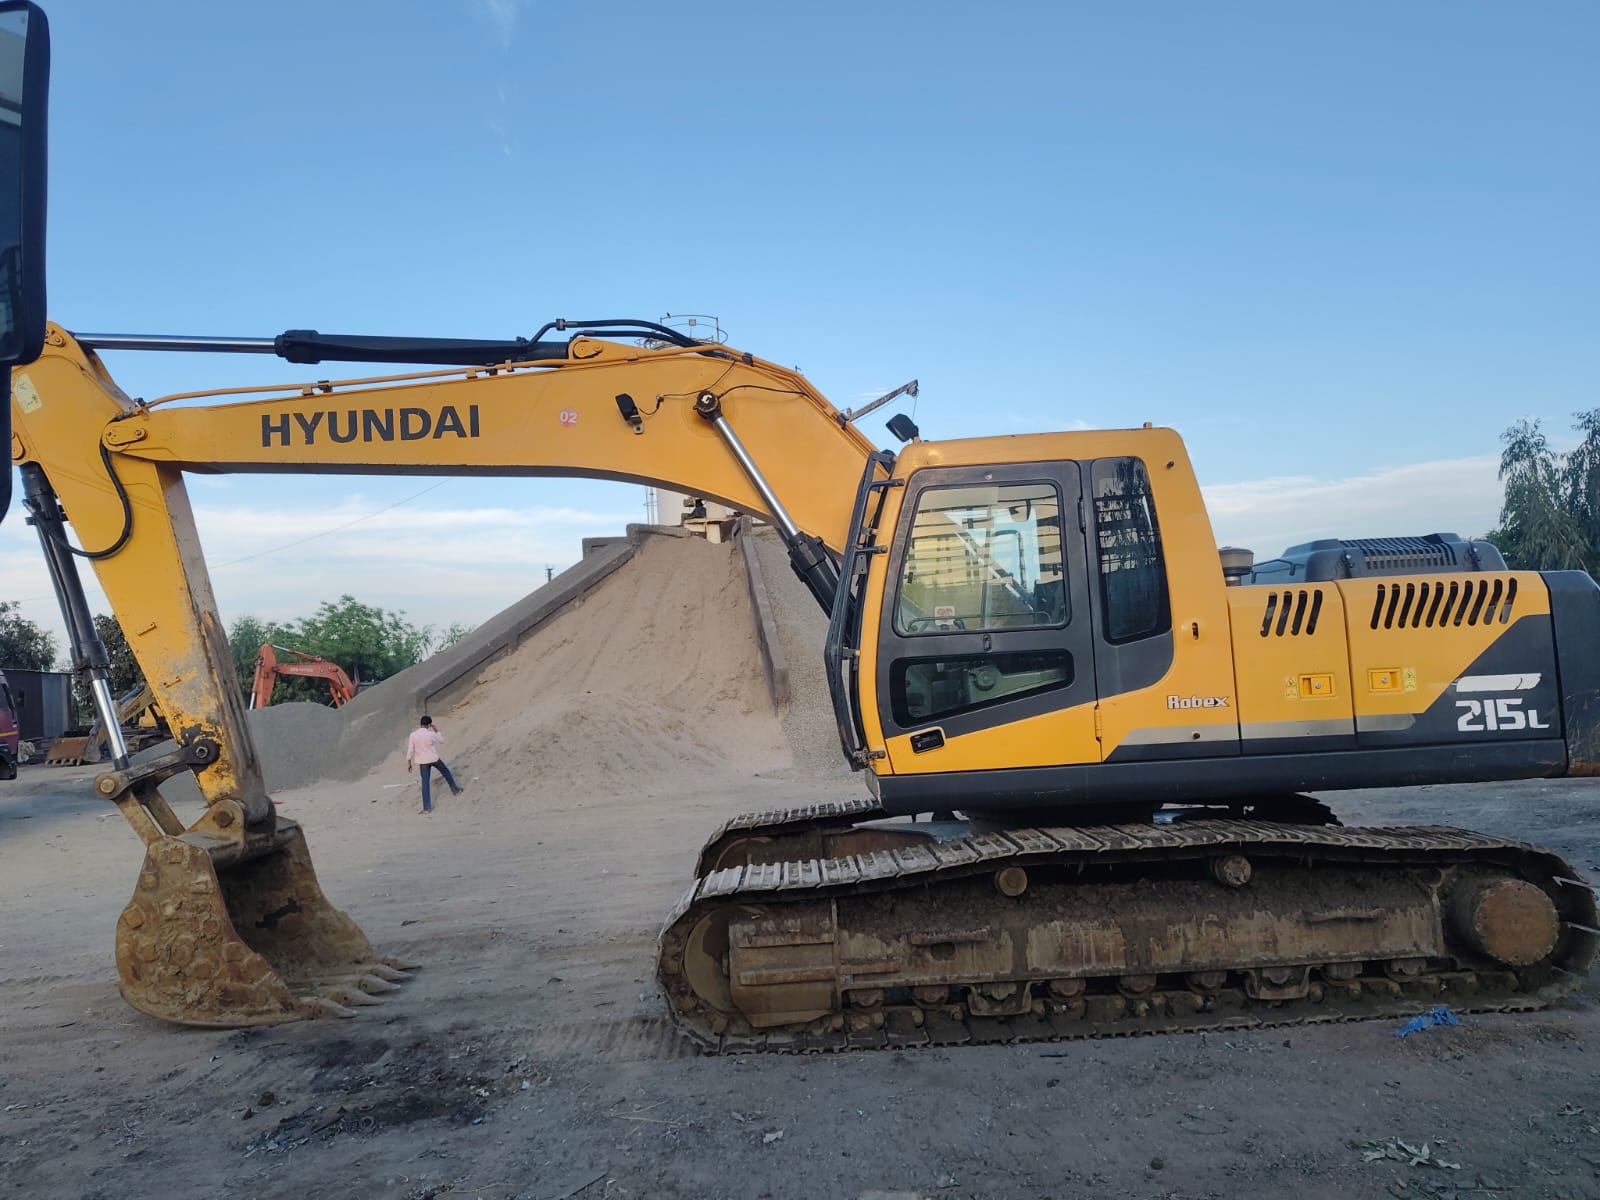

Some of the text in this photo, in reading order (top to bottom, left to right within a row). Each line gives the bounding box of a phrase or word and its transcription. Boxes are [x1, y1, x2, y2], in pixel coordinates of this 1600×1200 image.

[559, 411, 578, 424] 02
[261, 404, 480, 447] HYUNDAI
[1167, 694, 1230, 709] Robex
